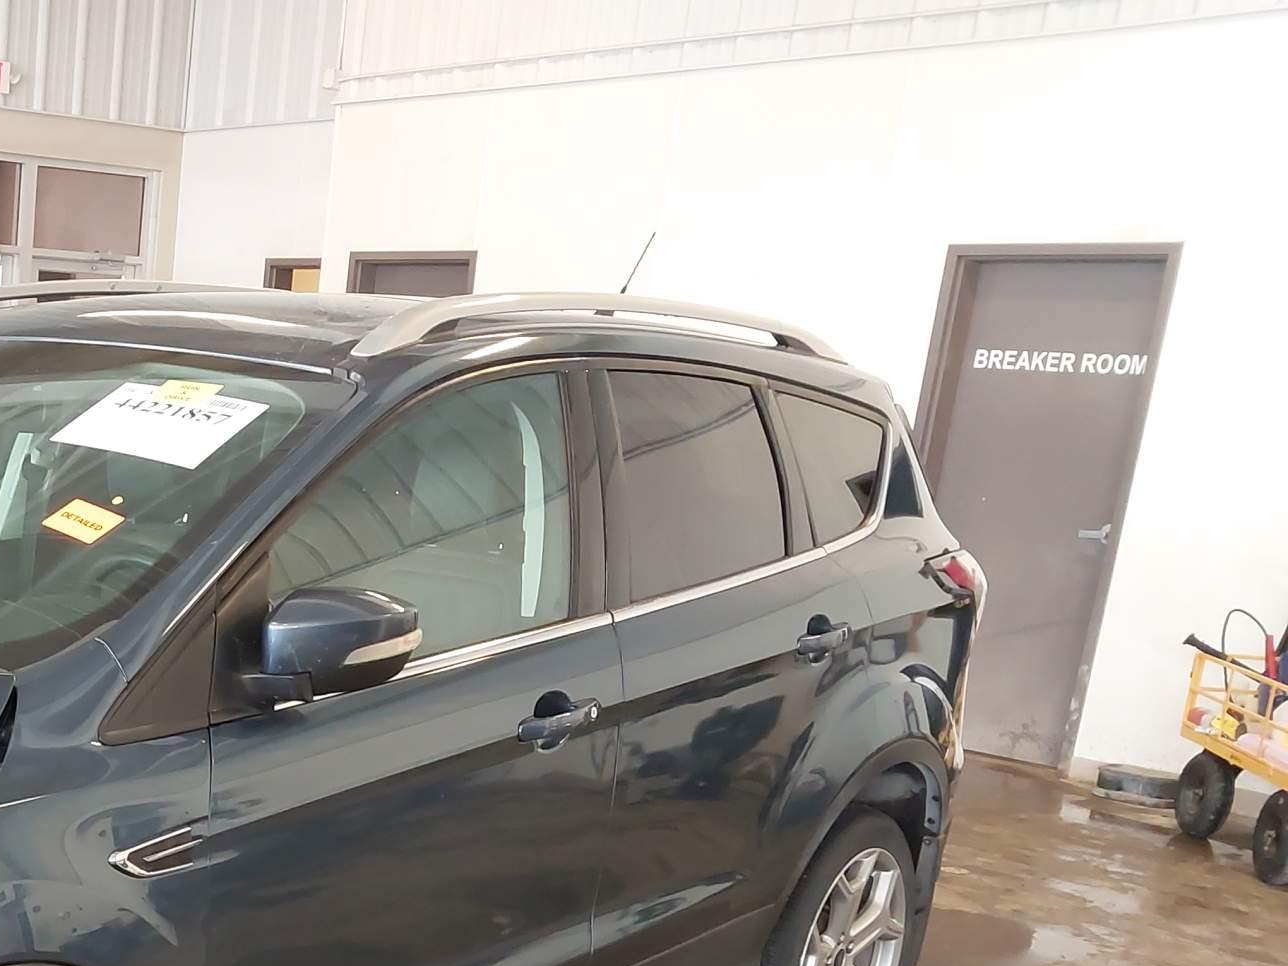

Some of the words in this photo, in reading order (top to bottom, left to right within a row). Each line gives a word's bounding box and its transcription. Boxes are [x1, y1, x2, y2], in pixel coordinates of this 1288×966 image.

[973, 348, 1076, 373] BREAKER
[1080, 352, 1148, 375] ROOM
[114, 398, 233, 425] 44221857
[60, 511, 103, 532] DETAILED
